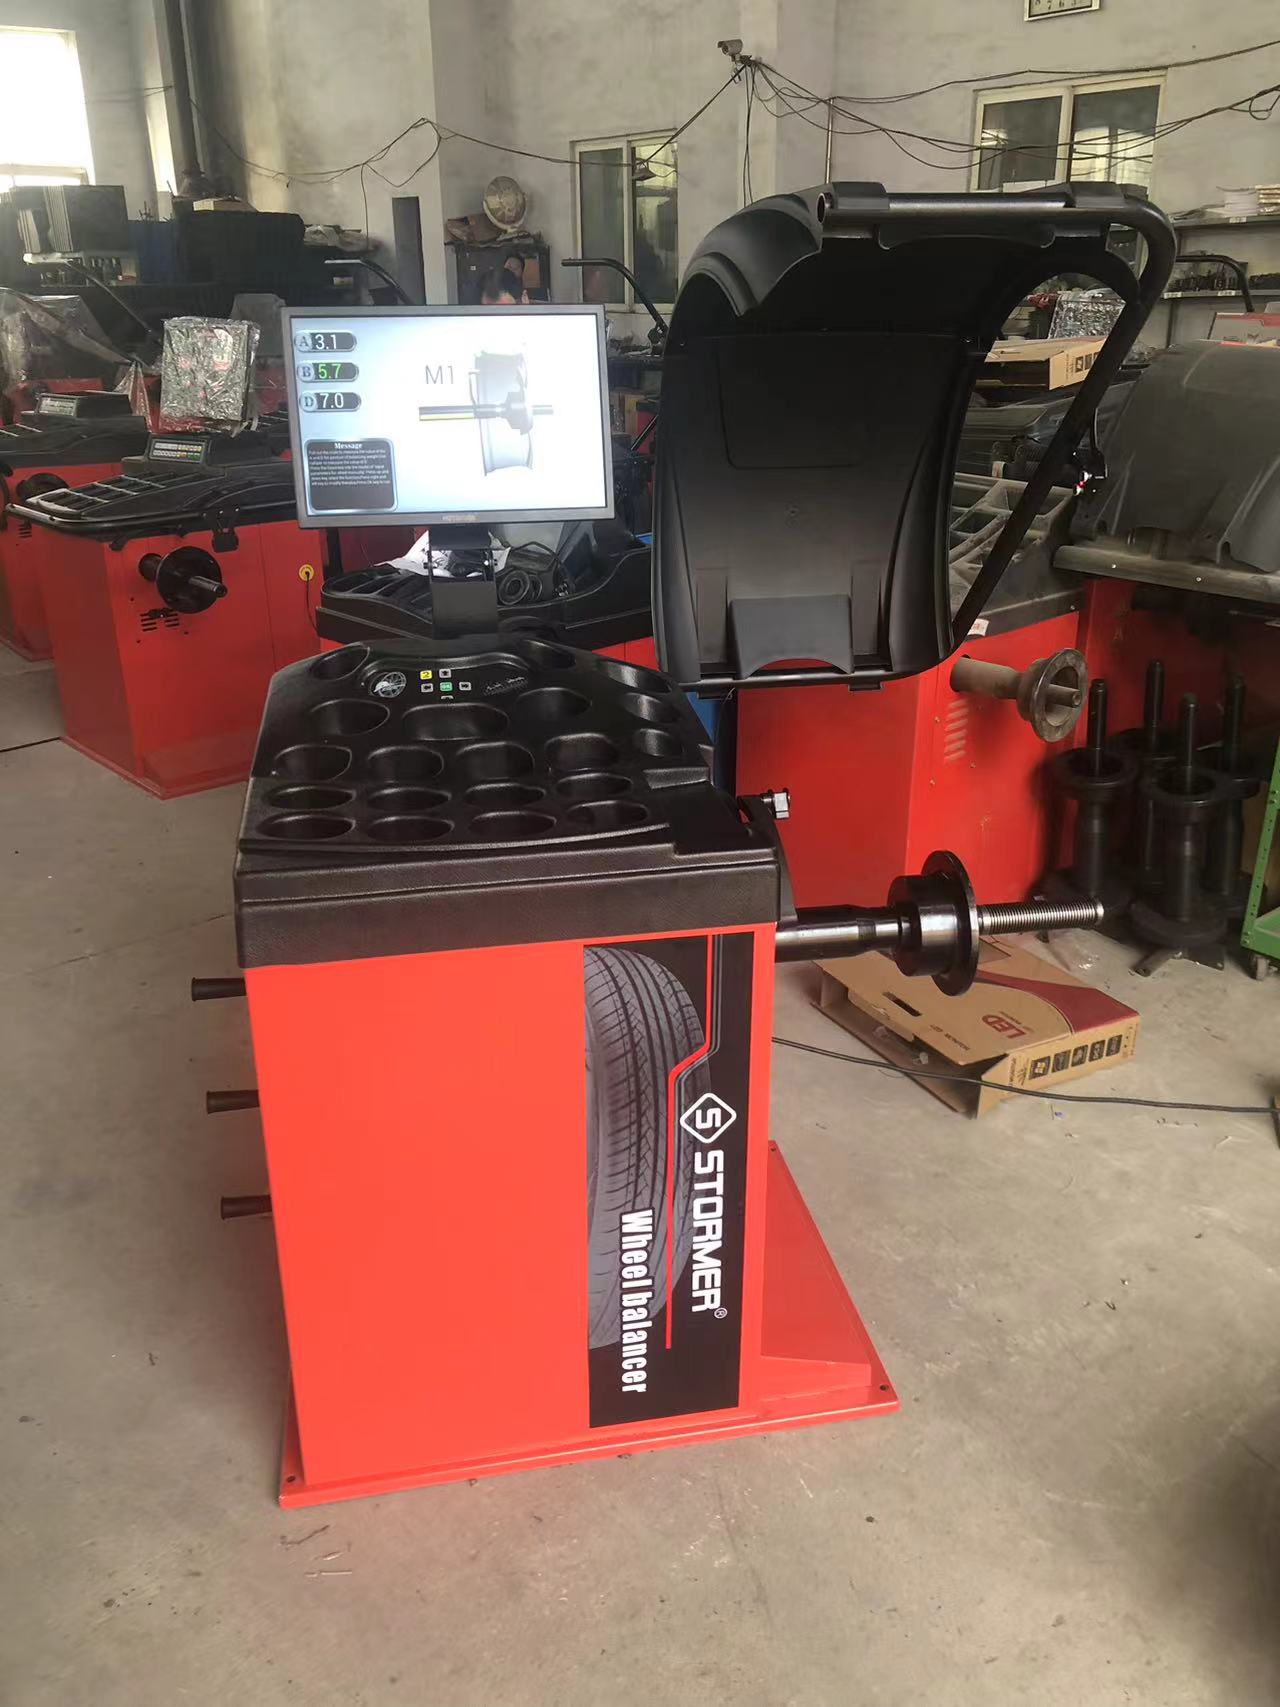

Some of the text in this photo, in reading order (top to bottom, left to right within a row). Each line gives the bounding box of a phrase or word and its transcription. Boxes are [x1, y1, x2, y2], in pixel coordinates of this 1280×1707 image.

[300, 334, 337, 350] A 3.1
[302, 363, 342, 379] B 5.7
[425, 364, 454, 384] M1
[304, 393, 344, 408] D 7.0
[334, 442, 363, 450] Message
[982, 1014, 1026, 1038] LED
[695, 1107, 721, 1129] S
[621, 1208, 653, 1392] Wheel balancer
